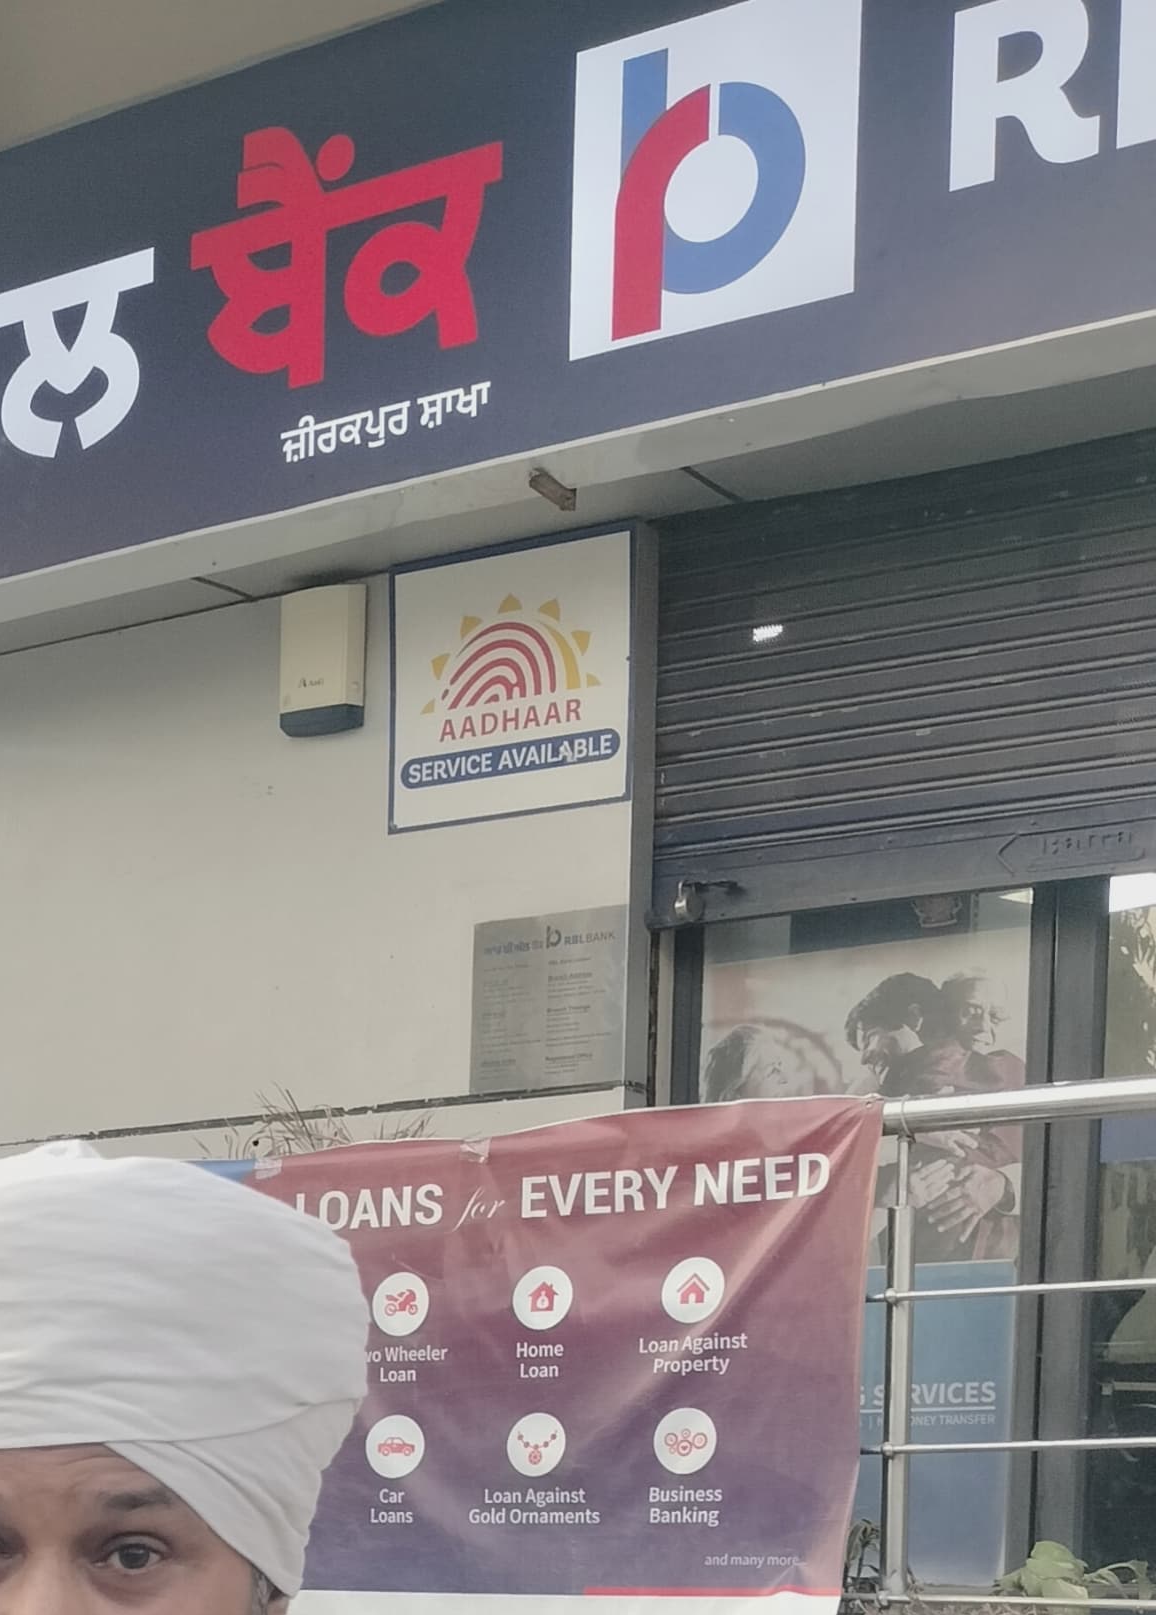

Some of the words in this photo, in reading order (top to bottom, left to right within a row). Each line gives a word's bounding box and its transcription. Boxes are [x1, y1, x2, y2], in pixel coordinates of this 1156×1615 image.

[949, 0, 1156, 192] R
[191, 127, 503, 389] ਬੈਂਕ
[417, 381, 492, 429] ਸ਼ਾਖਾ
[440, 698, 582, 742] AADHAAR
[408, 753, 493, 784] SERVICE
[498, 734, 612, 771] AVAILABLE
[521, 1165, 678, 1218] EVERY
[694, 1153, 830, 1205] NEED
[516, 1342, 564, 1359] Home
[639, 1337, 679, 1354] Loan
[681, 1332, 748, 1355] Against
[384, 1345, 448, 1363] Wheeler
[380, 1367, 416, 1382] Loan
[520, 1363, 559, 1379] Loan
[653, 1356, 730, 1376] Property
[873, 1381, 997, 1407] SRVICES
[939, 1414, 996, 1426] TRANSFER
[379, 1488, 405, 1504] Car
[484, 1488, 522, 1504] Loan
[525, 1486, 586, 1507] Against
[649, 1485, 723, 1503] Business
[370, 1508, 413, 1523] Loans
[468, 1508, 506, 1524] Gold
[510, 1508, 600, 1524] Ornaments
[649, 1506, 720, 1527] Banking
[704, 1553, 728, 1566] and
[731, 1556, 764, 1569] many
